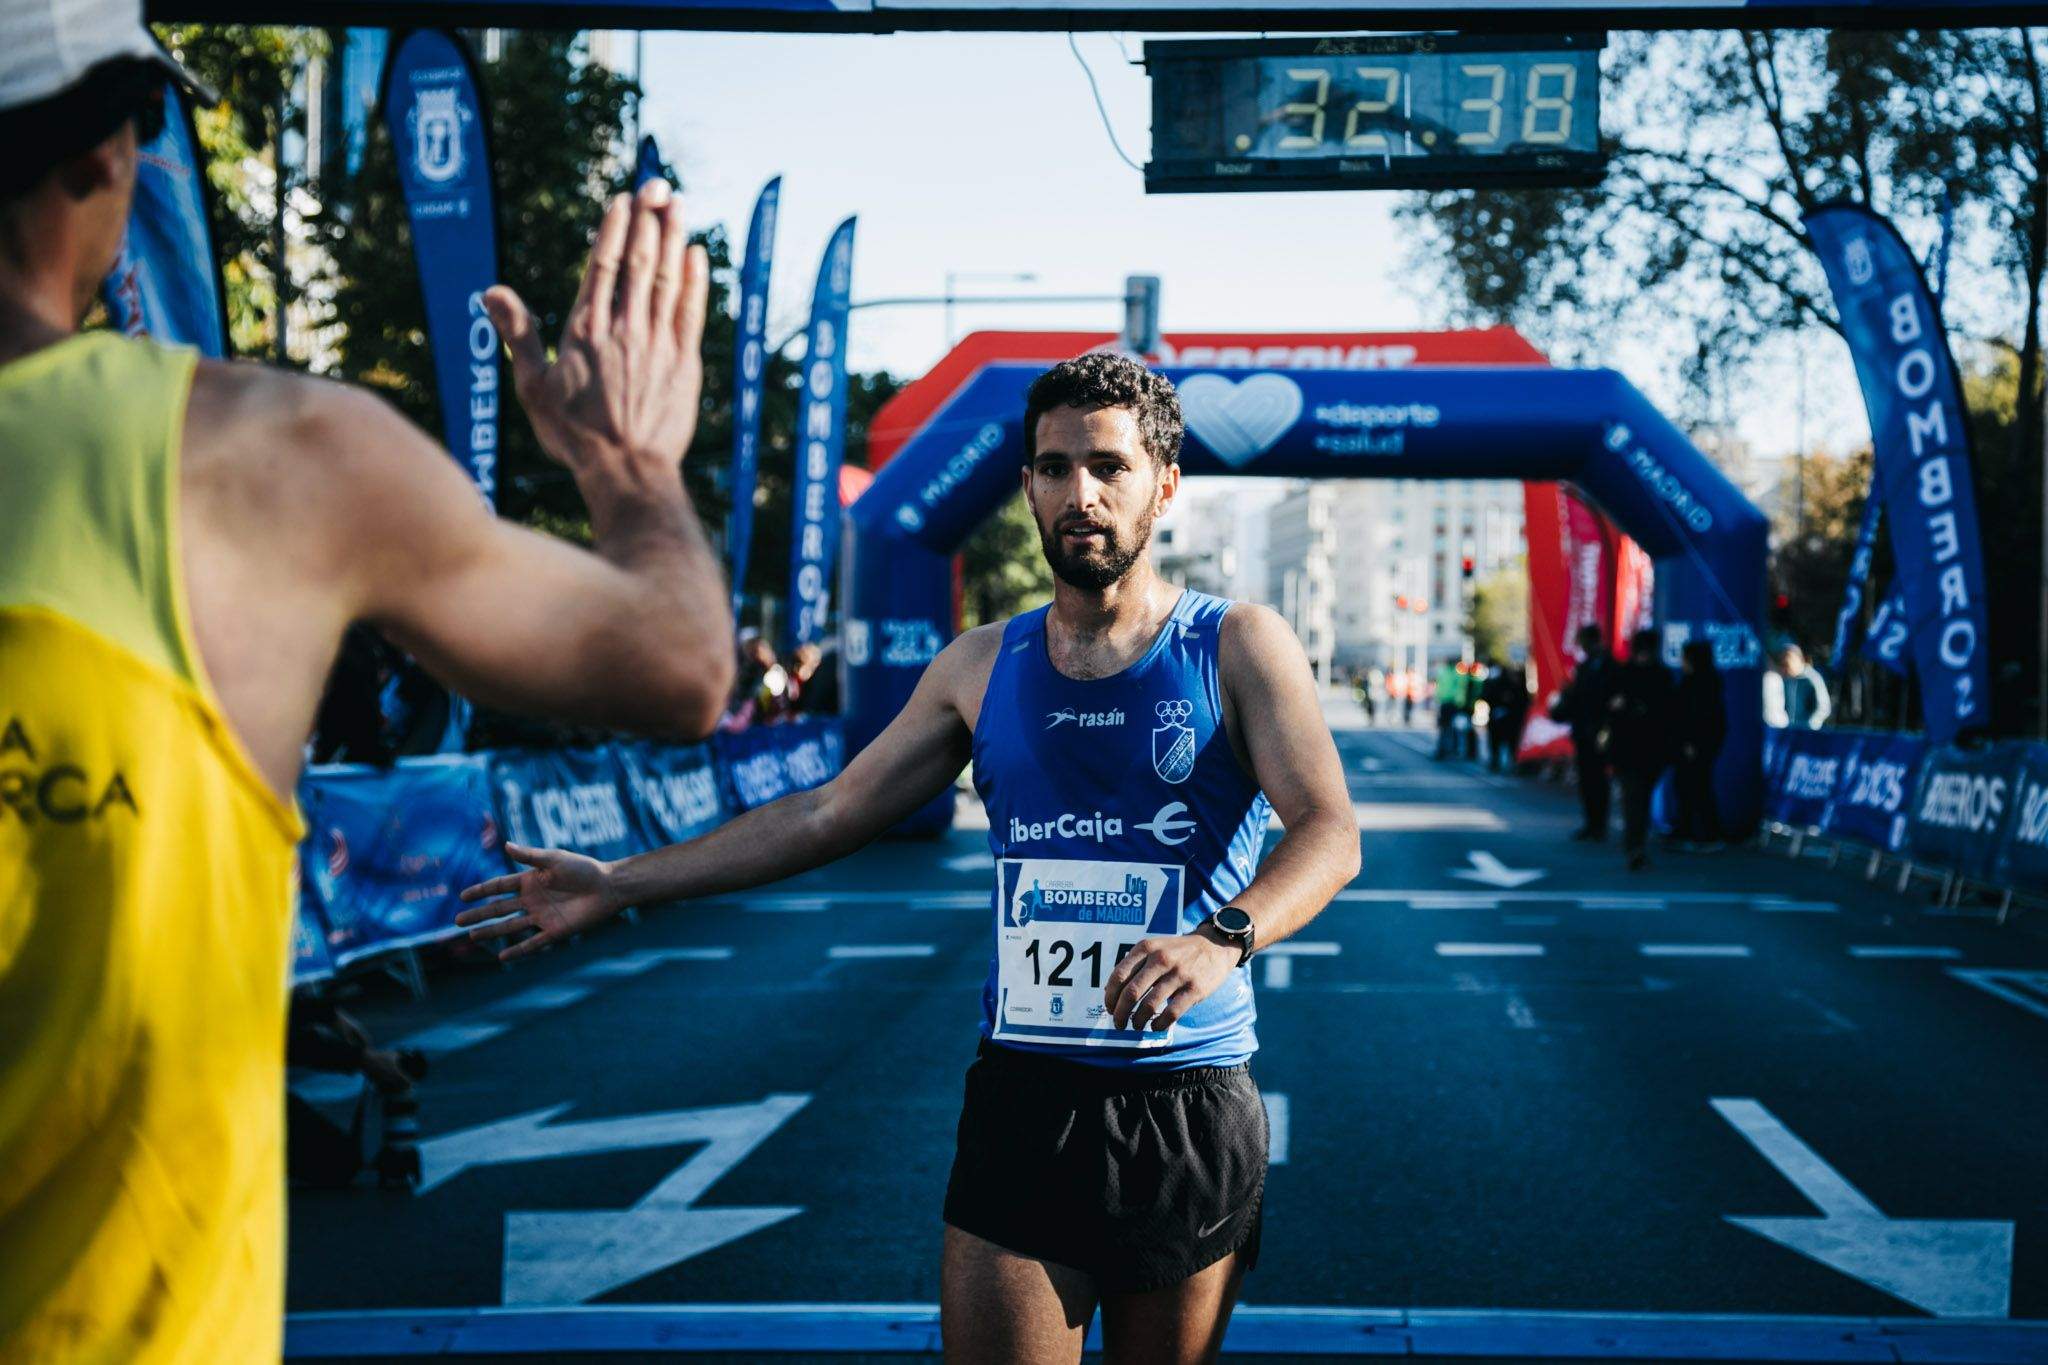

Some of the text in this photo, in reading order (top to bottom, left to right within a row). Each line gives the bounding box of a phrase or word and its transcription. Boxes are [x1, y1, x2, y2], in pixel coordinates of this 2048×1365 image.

[920, 422, 1005, 507] MADRID
[1627, 447, 1713, 533] MADRID
[1078, 707, 1126, 728] rasán
[1009, 811, 1123, 844] iberCaja
[1043, 890, 1143, 908] BOMBEROS
[1078, 906, 1143, 924] de MADRID
